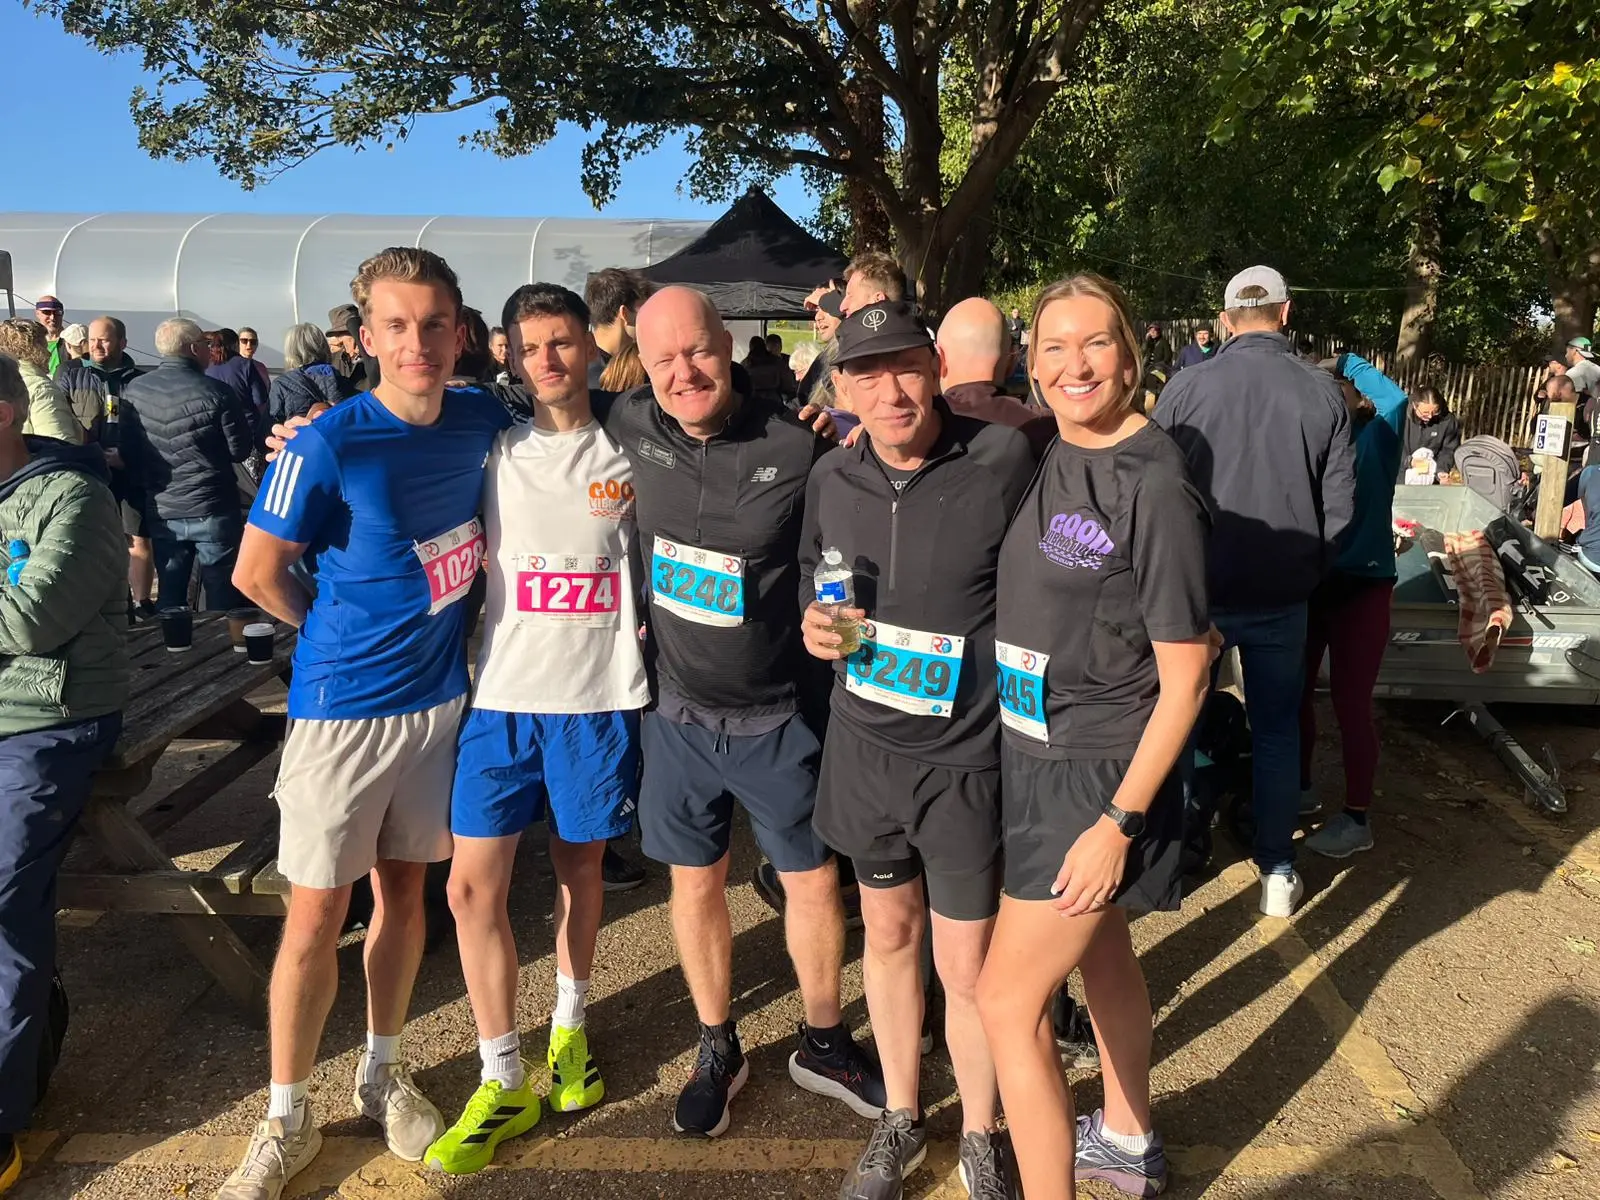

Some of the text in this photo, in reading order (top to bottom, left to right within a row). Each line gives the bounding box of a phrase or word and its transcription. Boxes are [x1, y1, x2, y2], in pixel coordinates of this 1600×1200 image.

[433, 539, 484, 595] 1028
[656, 562, 739, 612] 3248
[525, 575, 614, 610] 1274
